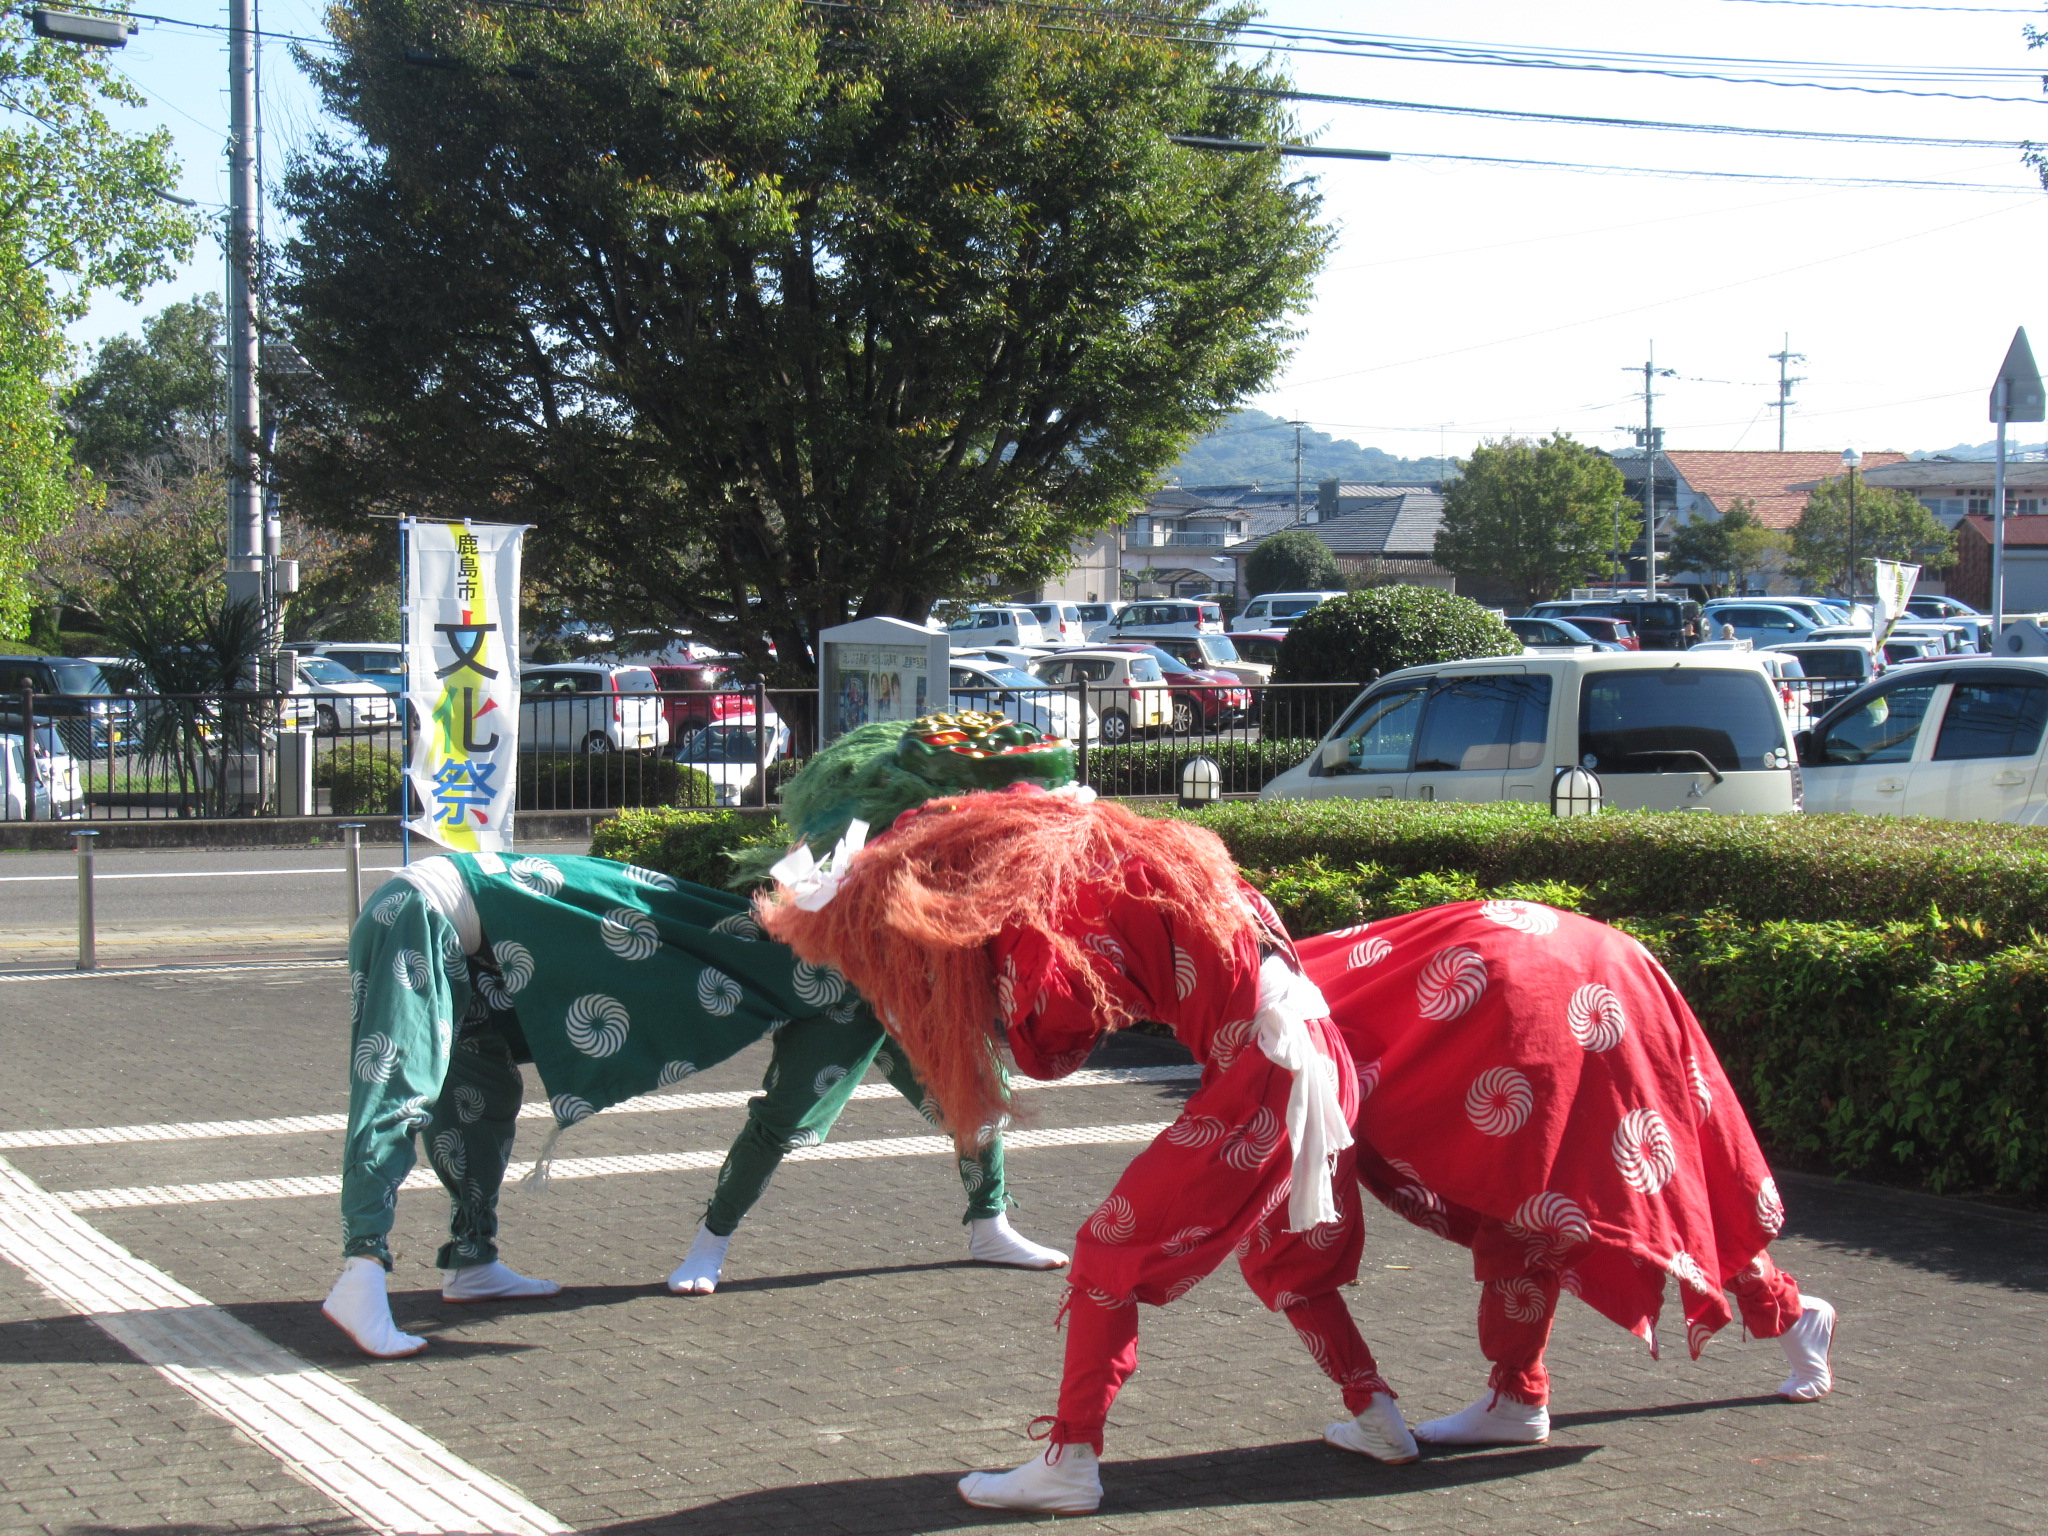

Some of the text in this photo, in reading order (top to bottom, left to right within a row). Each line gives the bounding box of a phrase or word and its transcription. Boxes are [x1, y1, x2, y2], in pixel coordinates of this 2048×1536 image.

[456, 533, 479, 602] 鹿島市
[431, 609, 500, 826] 文化祭
